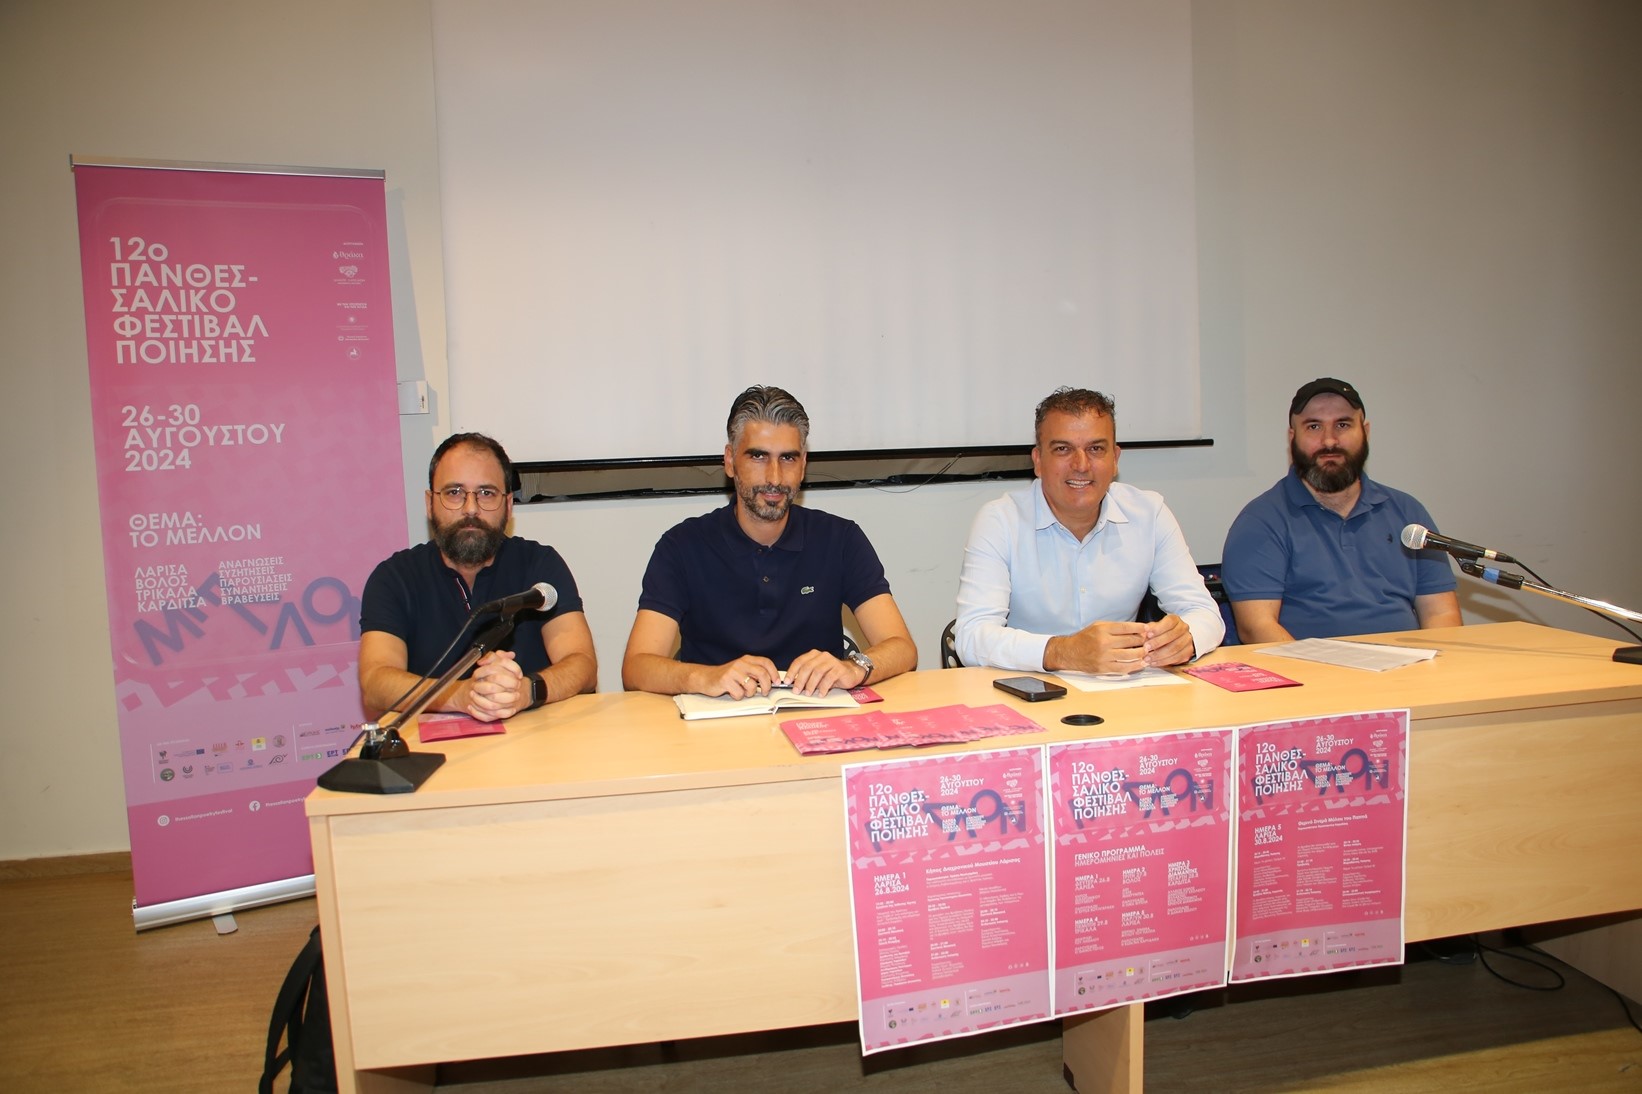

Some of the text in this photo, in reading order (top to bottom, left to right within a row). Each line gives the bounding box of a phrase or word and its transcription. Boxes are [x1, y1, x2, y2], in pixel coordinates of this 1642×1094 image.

[110, 237, 168, 261] 12ο
[110, 263, 258, 288] ΠΑΝΘΕΣ-
[112, 289, 236, 313] ΣΑΛΙΚΟ
[114, 314, 269, 338] ΦΕΣΤΙΒΑΛ
[116, 339, 256, 364] ΠΟΙΗΣΗΣ
[122, 404, 200, 426] 26-30
[124, 423, 286, 449] ΑΥΓΟΥΣΤΟΥ
[125, 448, 192, 472] 2024
[129, 512, 203, 531] ΘΕΜΑ:
[130, 524, 262, 548] ΤΟ ΜΕΛΛΟΝ
[134, 564, 188, 578] ΛΑΡΙΣΑ
[218, 556, 284, 570] ΑΝΑΓΝΩΣΕΙΣ
[218, 566, 276, 578] ΣΥΖΗΤΗΣΕΙΣ
[135, 575, 188, 590] ΒΟΛΟΣ
[219, 574, 292, 588] ΠΑΡΟΥΣΙΑΣΕΙΣ
[220, 582, 288, 596] ΣΥΝΑΝΤΗΣΕΙΣ
[136, 586, 198, 601] ΤΡΙΚΑΛΑ
[221, 592, 280, 606] ΒΡΑΒΕΥΣΕΙΣ
[137, 596, 207, 612] ΚΑΡΔΙΤΣΑ
[1256, 748, 1306, 764] ΠΑΝΘΕΣ-
[1315, 746, 1331, 754] 2024
[1139, 754, 1158, 763] 26-30
[1139, 768, 1156, 776] 2024
[1255, 760, 1298, 776] ΣΑΛΙΚΟ
[940, 774, 961, 783] 26-30
[940, 778, 984, 790] ΑΥΓΟΥΣΤΟΥ
[1072, 769, 1130, 785] ΠΑΝΘΕΣ-
[1255, 770, 1308, 786] ΦΕΣΤΙΒΑΛ
[941, 788, 959, 796] 2024
[1072, 781, 1121, 797] ΣΑΛΙΚΟ
[1255, 780, 1303, 796] ΠΟΙΗΣΗΣ
[869, 790, 930, 808] ΠΑΝΘΕΣ-
[1073, 792, 1132, 808] ΦΕΣΤΙΒΑΛ
[870, 802, 920, 819] ΣΑΛΙΚΟ
[1074, 803, 1127, 820] ΠΟΙΗΣΗΣ
[870, 813, 934, 830] ΦΕΣΤΙΒΑΛ
[871, 825, 929, 843] ΠΟΙΗΣΗΣ
[1074, 844, 1146, 862] ΓΕΝΙΚΟ ΠΡΟΓΡΑΜΜΑ
[1074, 848, 1164, 867] ΗΜΕΡΟΜΗΝΙΕΣ ΚΑΙ ΠΟΛΕΙΣ
[874, 873, 900, 882] ΗΜΕΡΑ
[875, 884, 910, 896] 26.8.2024
